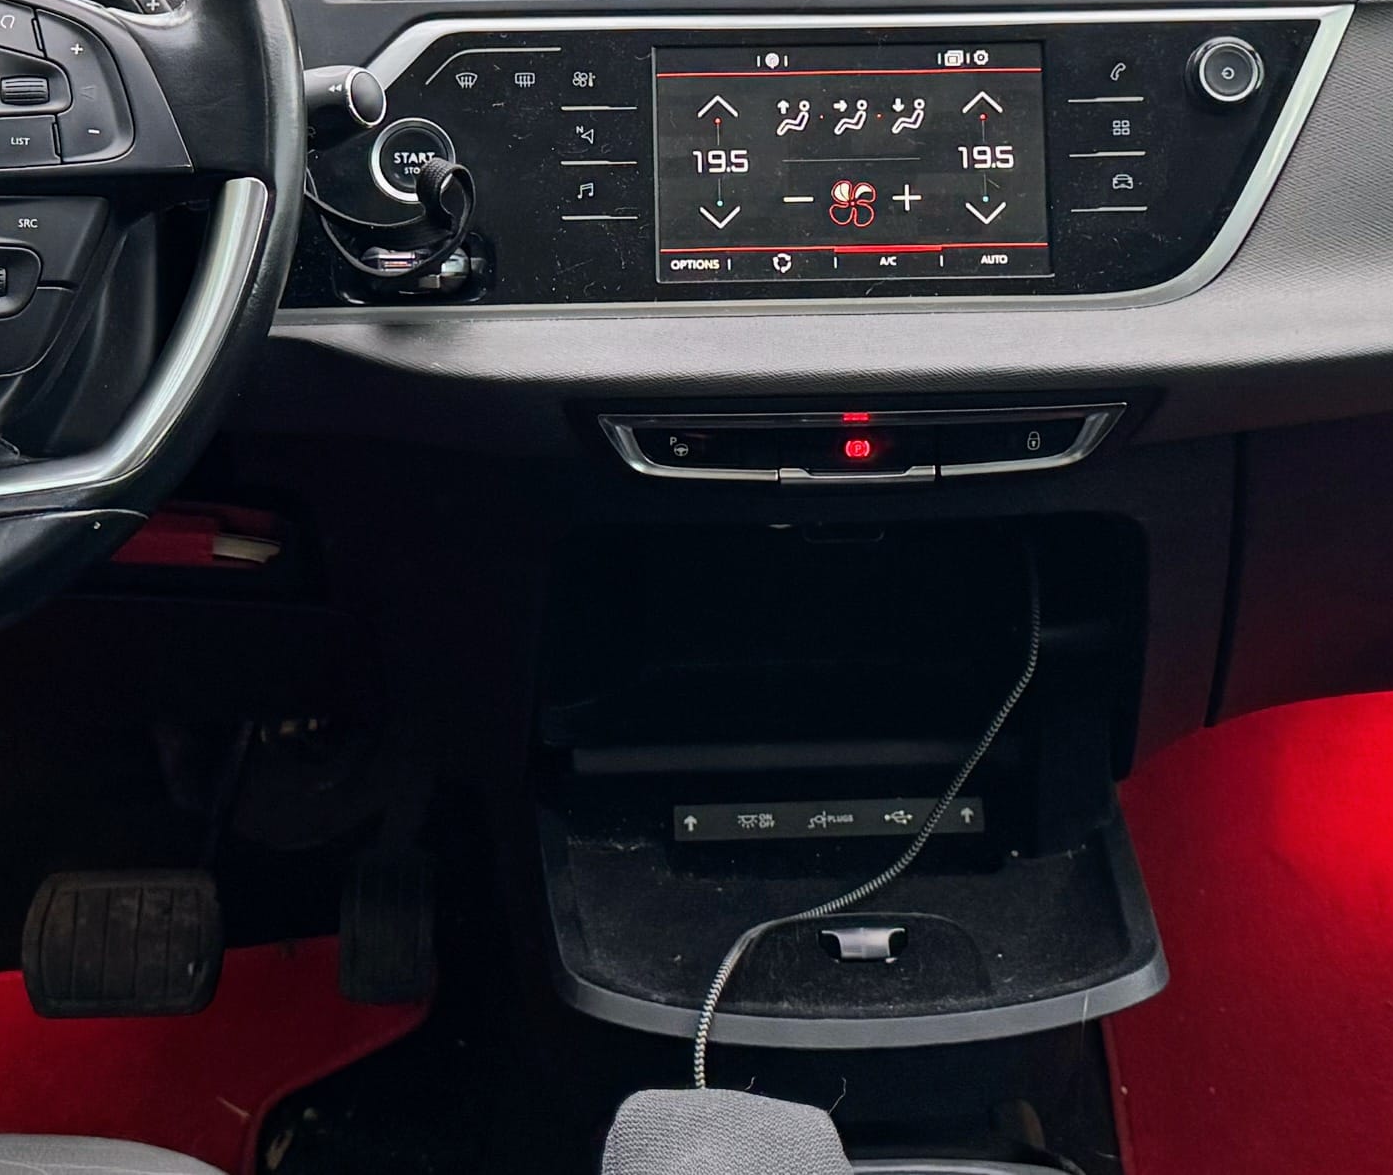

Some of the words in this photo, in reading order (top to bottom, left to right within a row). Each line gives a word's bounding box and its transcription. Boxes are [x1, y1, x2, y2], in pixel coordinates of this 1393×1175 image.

[10, 136, 30, 145] LIST
[393, 151, 435, 164] START
[692, 149, 749, 173] 19.5
[958, 145, 1014, 169] 19.5
[404, 166, 423, 175] STO
[17, 218, 38, 229] SRC
[670, 259, 720, 271] OPTIONS
[879, 254, 897, 267] A/C
[980, 254, 1008, 265] AUTO
